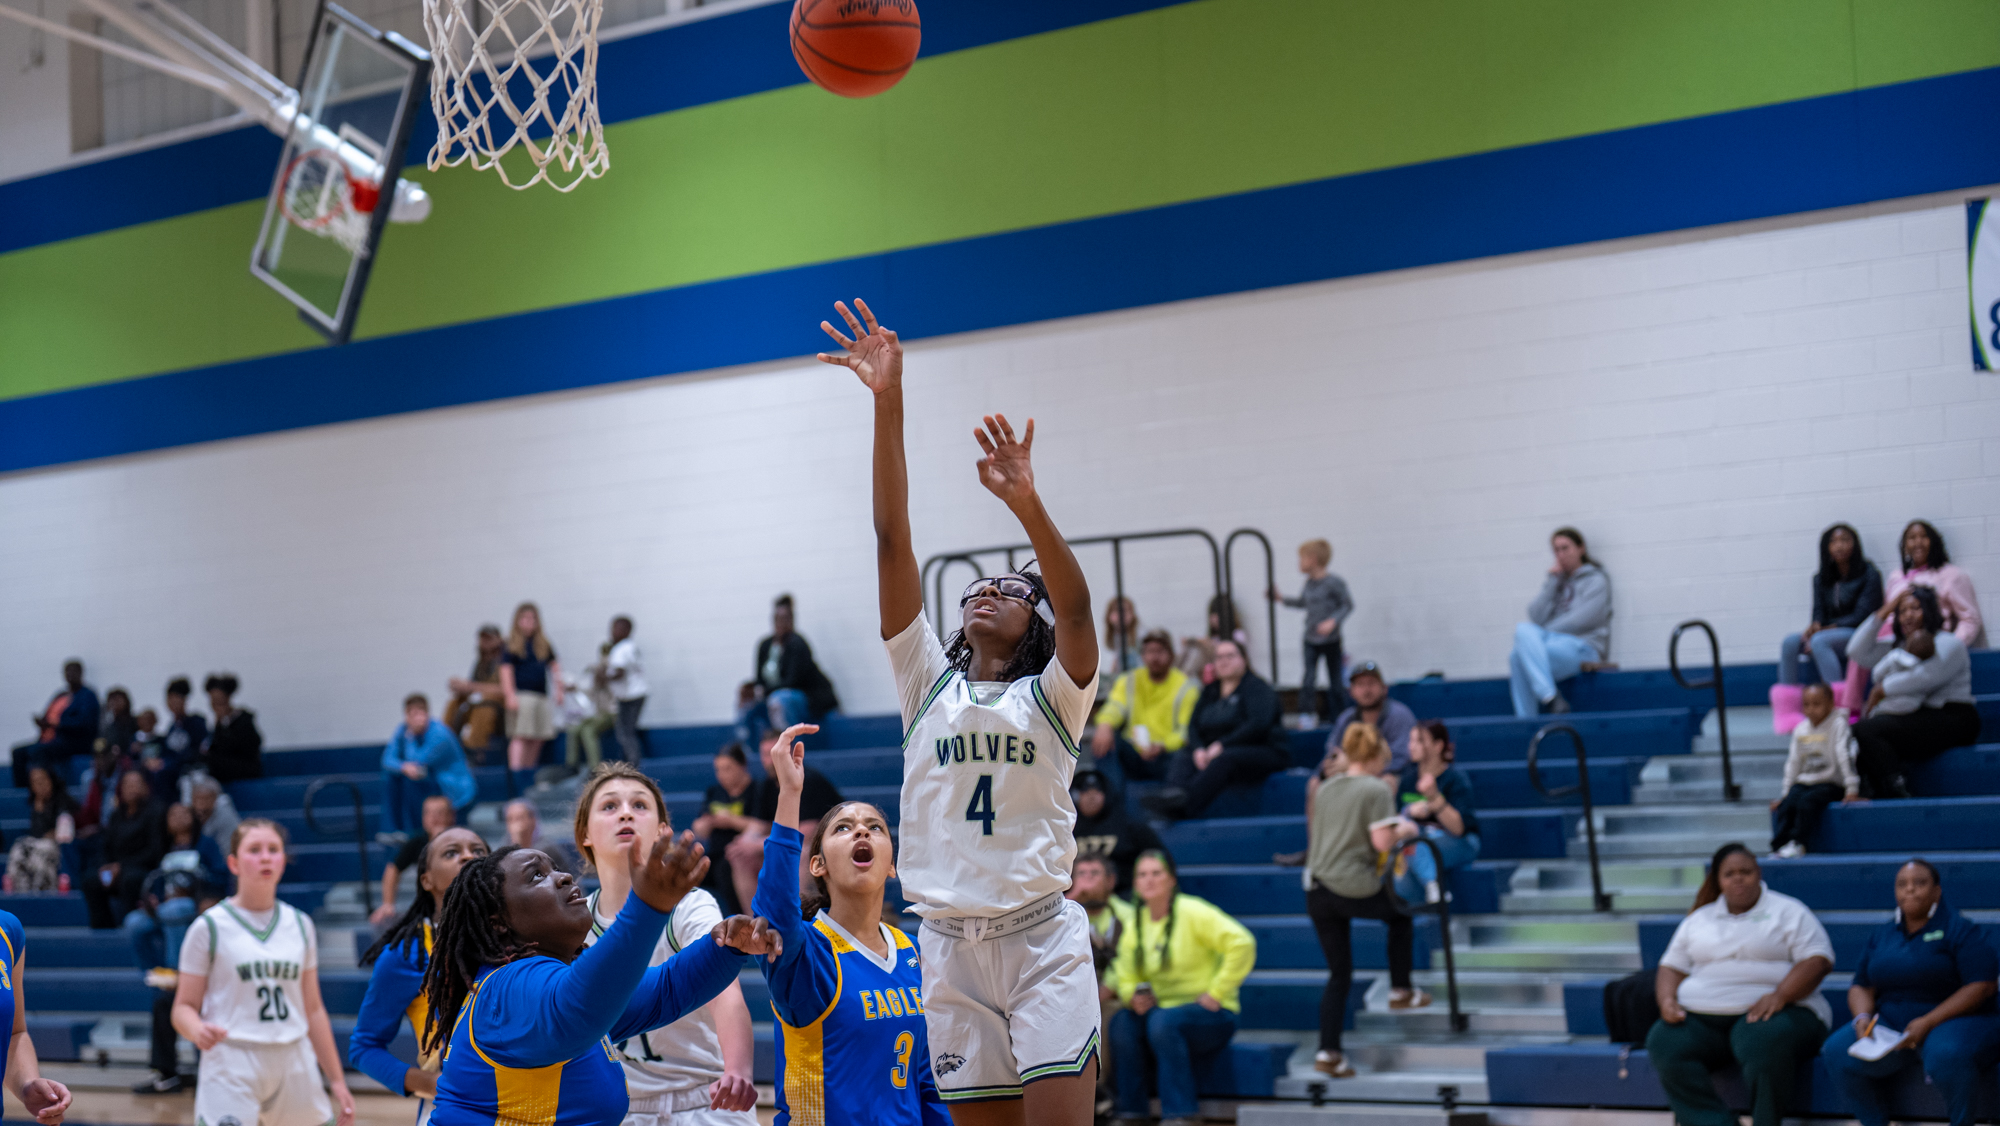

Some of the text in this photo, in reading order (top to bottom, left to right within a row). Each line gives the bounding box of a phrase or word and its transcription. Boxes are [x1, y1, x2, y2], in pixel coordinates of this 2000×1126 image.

[935, 731, 1038, 767] WOLVES
[965, 774, 996, 836] 4
[1011, 896, 1061, 926] DYNAMIC
[236, 960, 299, 981] WOLVES
[257, 985, 289, 1021] 20
[859, 987, 925, 1021] EAGLE
[890, 1030, 914, 1089] 3
